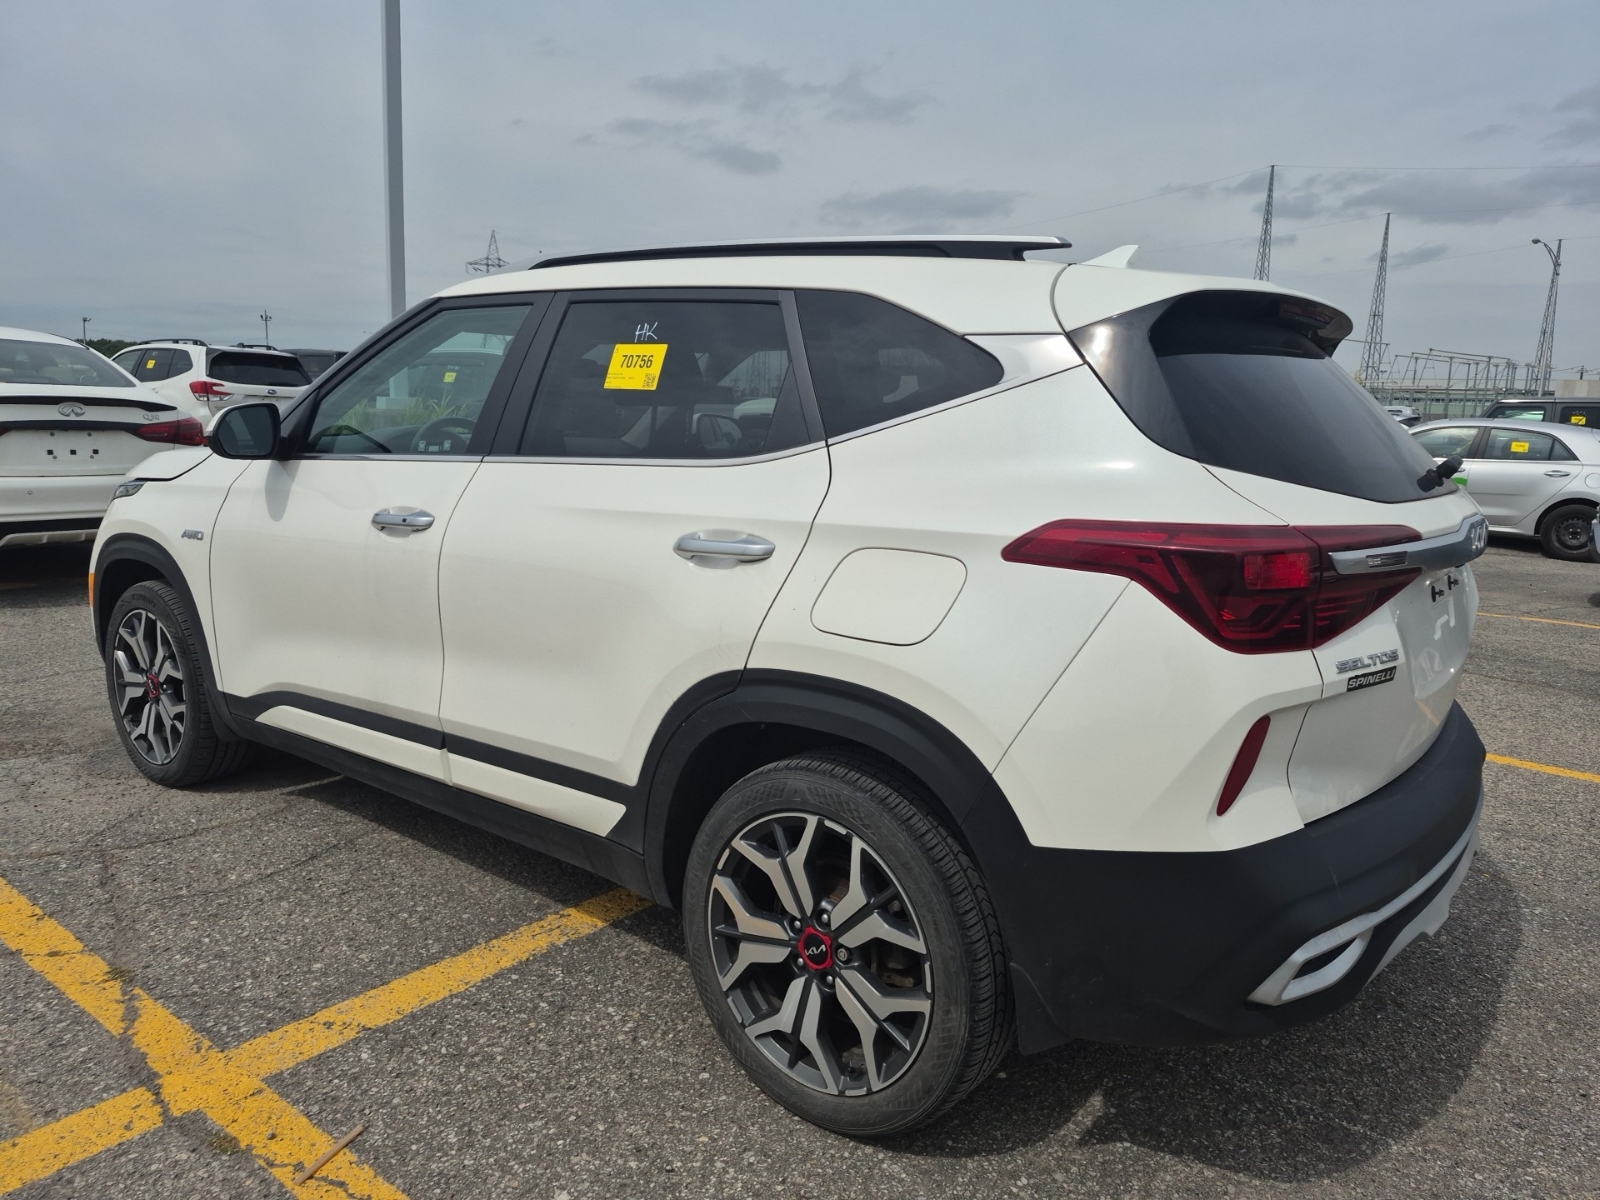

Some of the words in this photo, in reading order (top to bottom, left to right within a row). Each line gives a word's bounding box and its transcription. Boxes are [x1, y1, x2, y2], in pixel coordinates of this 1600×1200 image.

[634, 321, 659, 343] HK
[620, 354, 654, 369] 70756
[1335, 649, 1400, 674] SELTOS
[1348, 669, 1396, 689] SPINELLI
